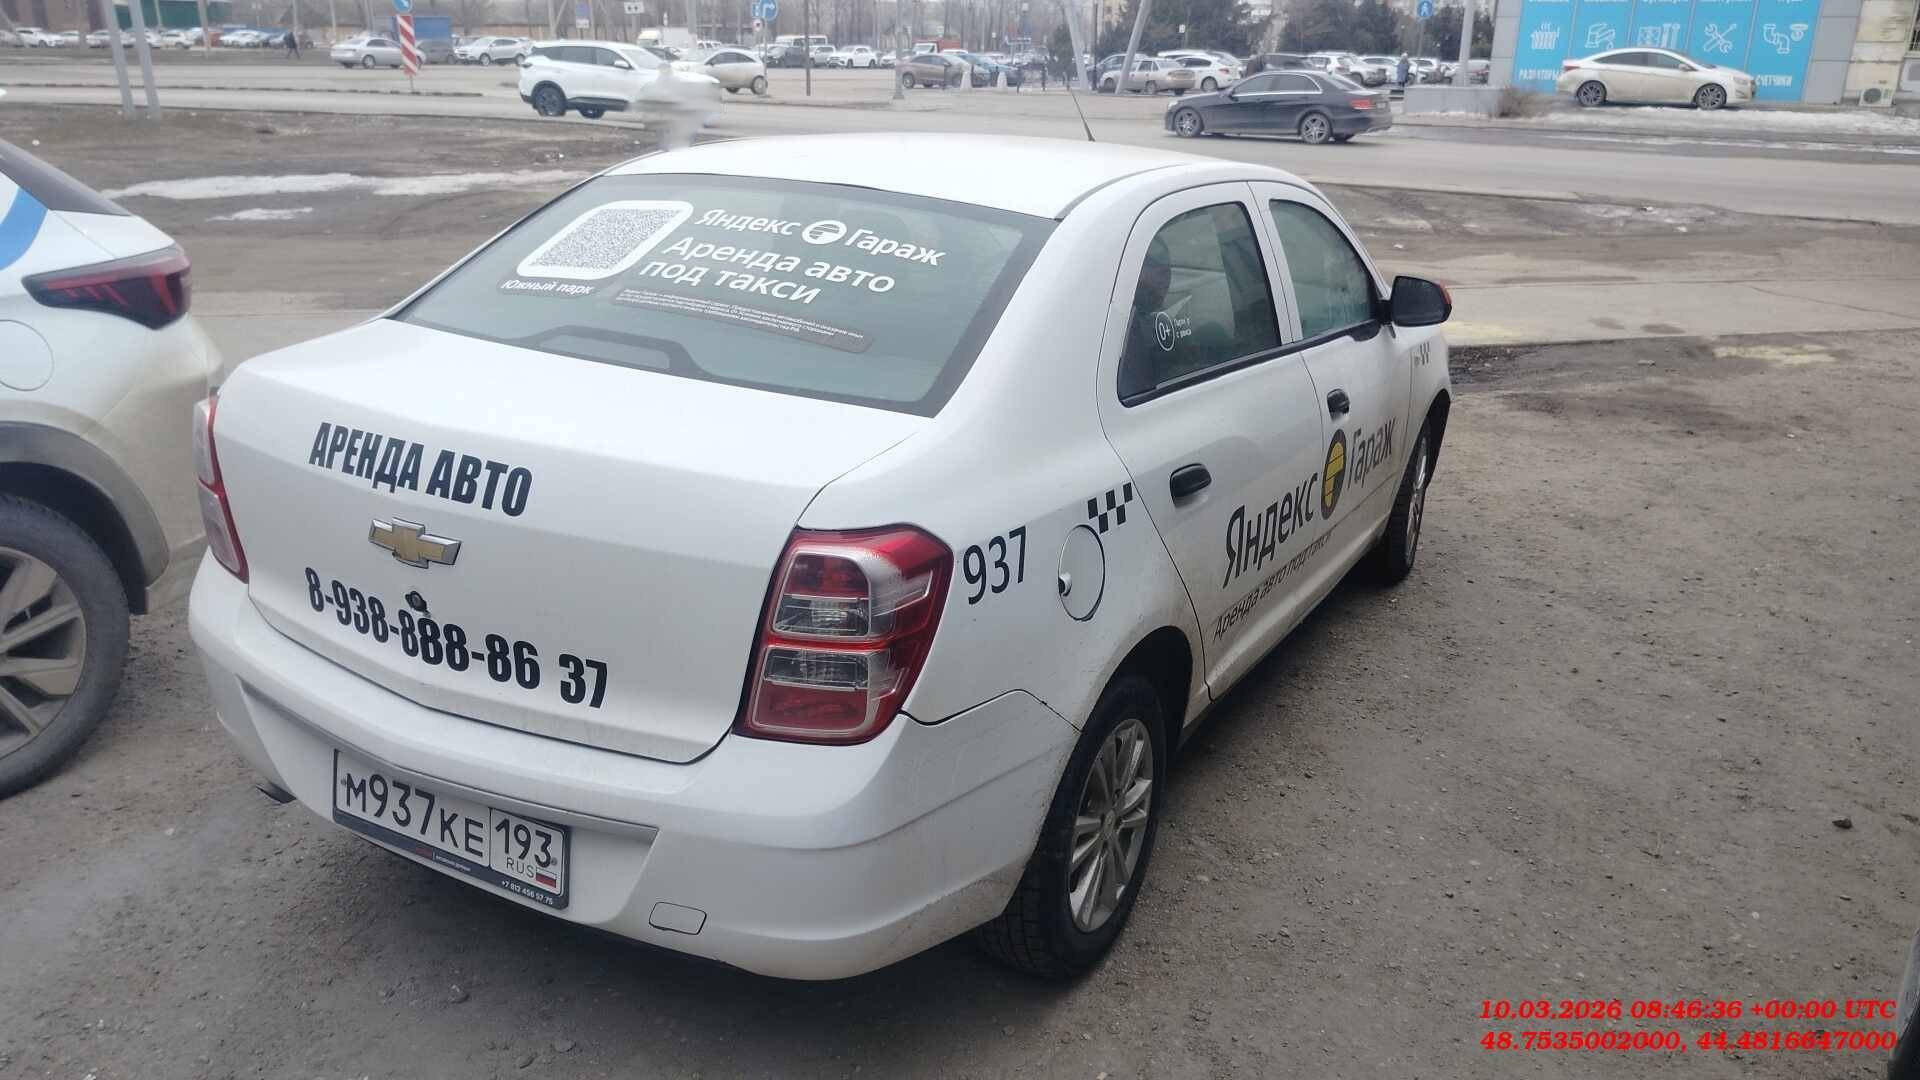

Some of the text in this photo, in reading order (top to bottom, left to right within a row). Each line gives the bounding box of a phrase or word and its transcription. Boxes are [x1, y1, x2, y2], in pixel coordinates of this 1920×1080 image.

[663, 236, 896, 293] Аренда авто
[694, 208, 947, 266] Яндекс Гараж
[501, 279, 595, 296] Южный парк
[639, 261, 822, 304] под такси
[308, 422, 533, 517] АРЕНДА АВТО
[1222, 416, 1396, 589] Яндекс Гараж
[963, 525, 1026, 605] 937
[1213, 588, 1260, 644] Аренда
[1260, 564, 1287, 599] авто
[304, 567, 608, 709] 8-938-888-86 37
[495, 818, 552, 868] 193
[506, 857, 535, 878] RUS
